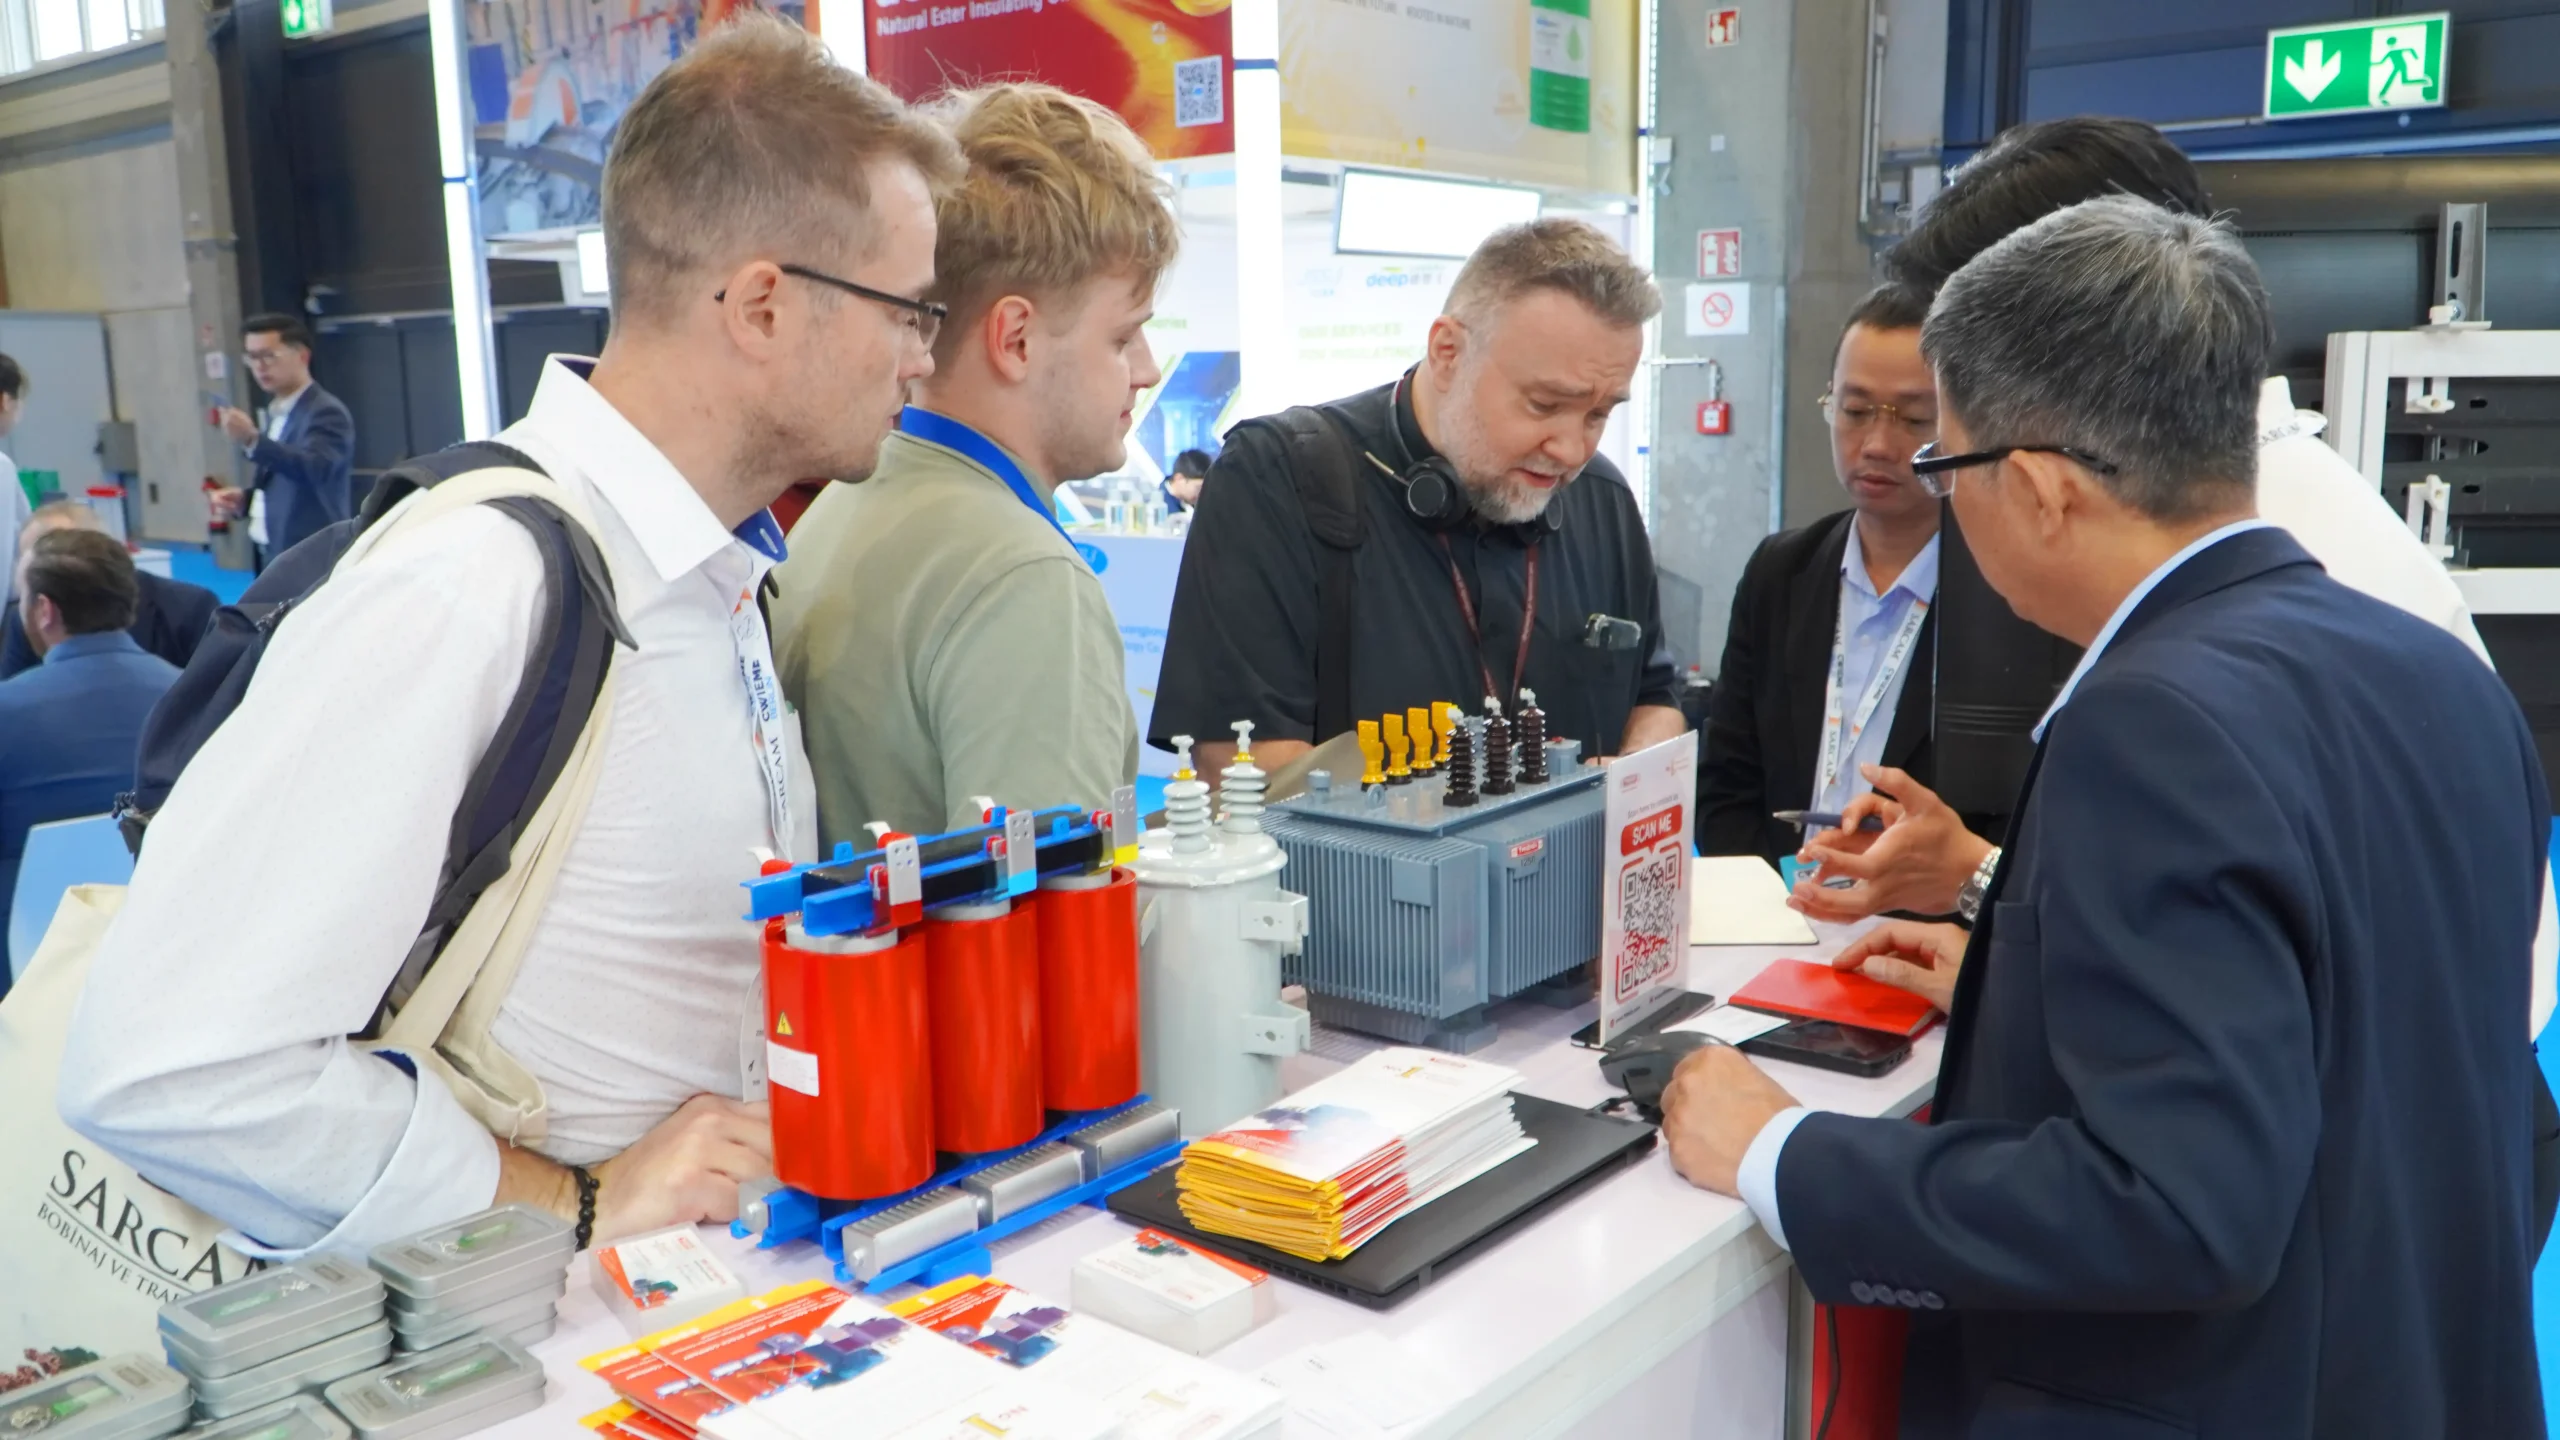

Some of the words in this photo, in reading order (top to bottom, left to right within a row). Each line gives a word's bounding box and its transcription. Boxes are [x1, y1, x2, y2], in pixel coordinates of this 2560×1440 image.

[876, 9, 928, 36] Natural
[930, 6, 966, 27] Ester
[969, 0, 1043, 19] Insulating
[1366, 272, 1408, 288] deep
[753, 659, 770, 722] CWIEME
[1632, 819, 1657, 846] SCAN
[1659, 812, 1672, 834] ME
[37, 1202, 108, 1269] BOBİNAJ
[110, 1260, 131, 1284] VE
